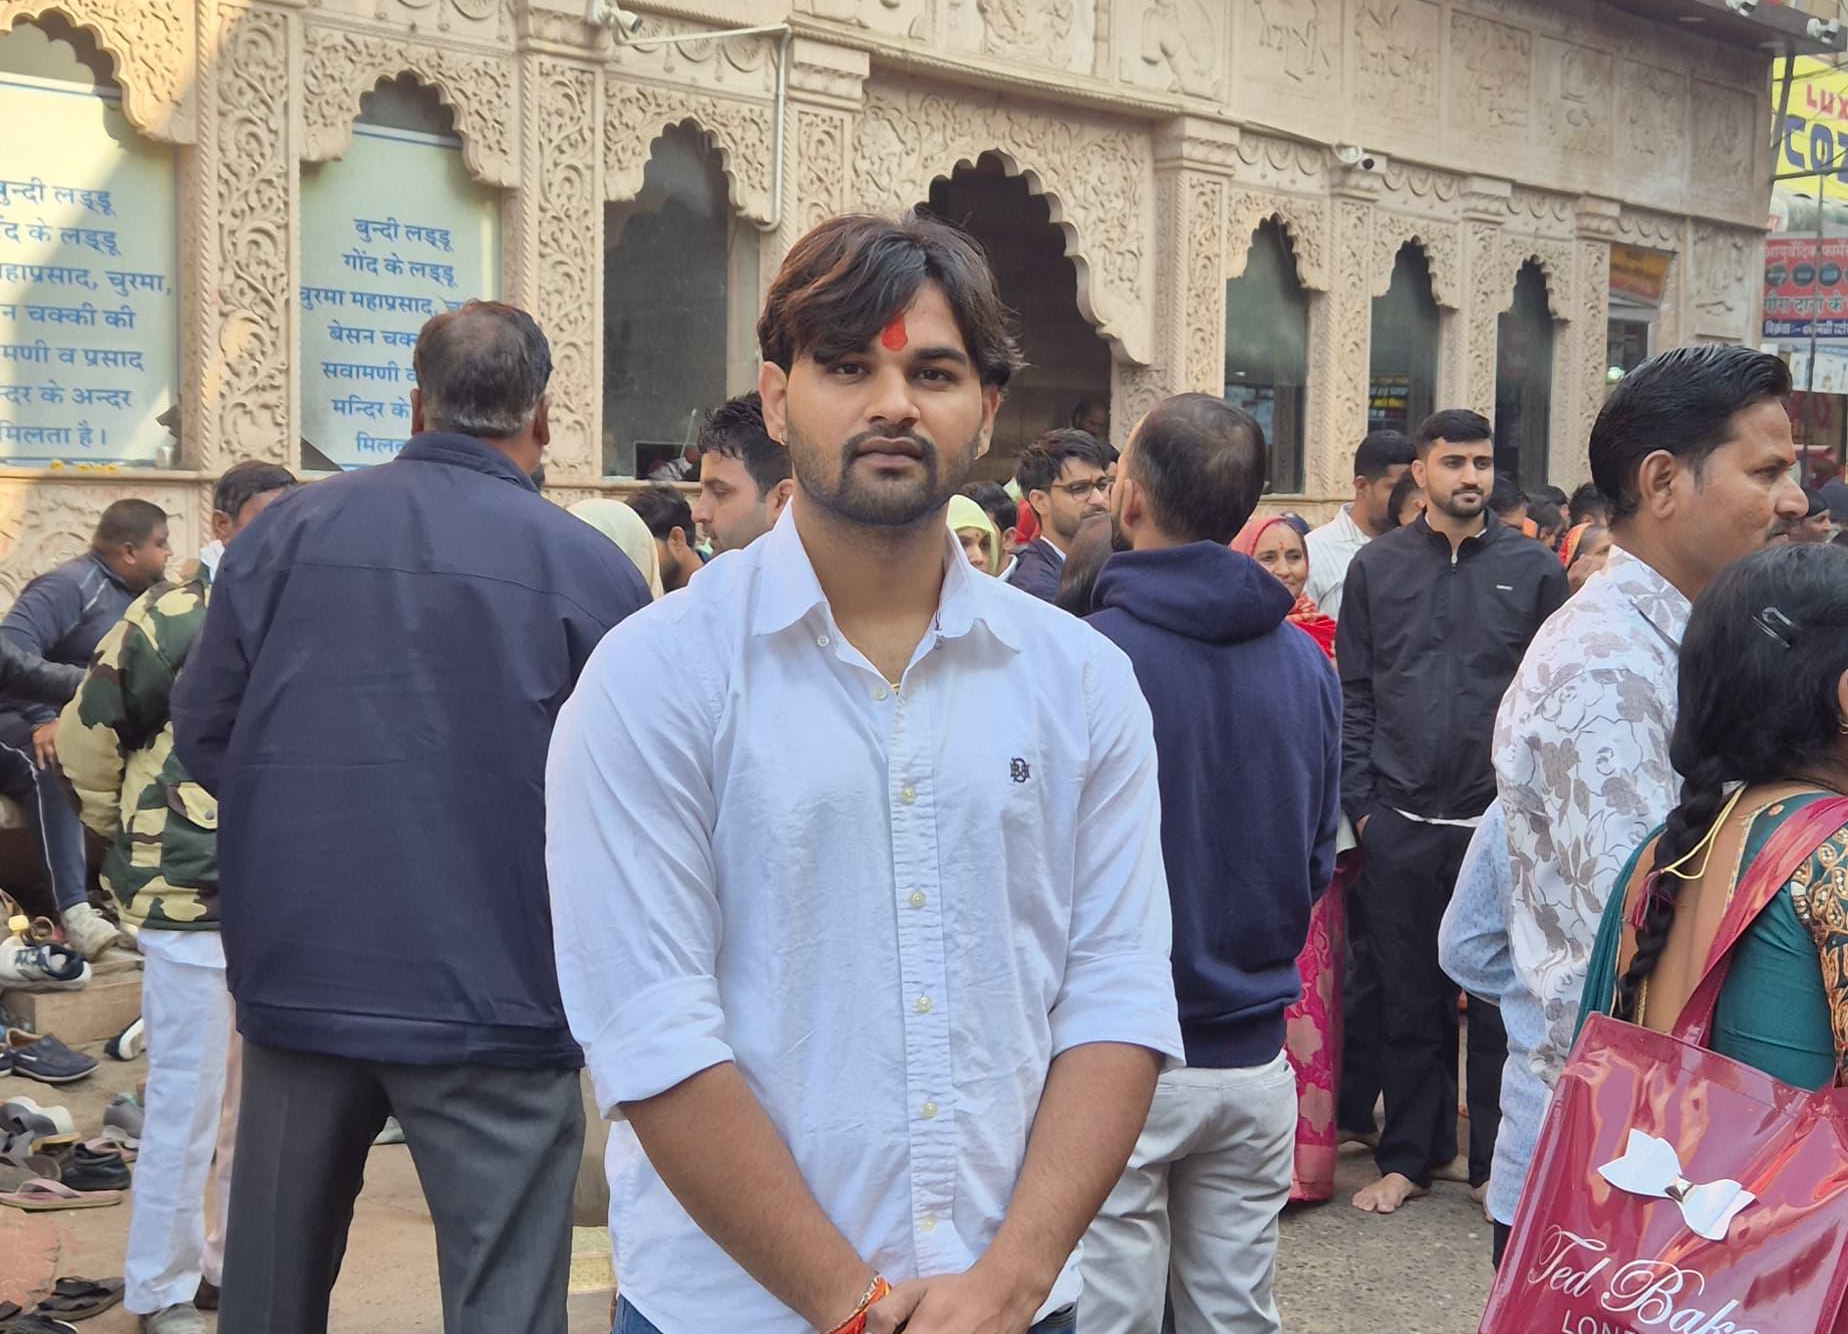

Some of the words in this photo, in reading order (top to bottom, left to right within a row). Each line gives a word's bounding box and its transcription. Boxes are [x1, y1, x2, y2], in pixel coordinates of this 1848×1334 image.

[353, 216, 401, 244] बुन्दी
[343, 248, 379, 276] गोंद
[384, 252, 404, 276] के
[0, 263, 98, 292] हाप्रसाद,
[25, 301, 98, 327] चक्की
[103, 304, 136, 330] की
[327, 319, 375, 345] बेसन
[57, 347, 77, 365] व
[83, 347, 144, 372] प्रसाद
[321, 361, 401, 382] सवामणी
[38, 378, 64, 405] के
[72, 387, 133, 409] अन्दर
[331, 394, 385, 421] मन्दिर
[1527, 1224, 1609, 1298] Ted
